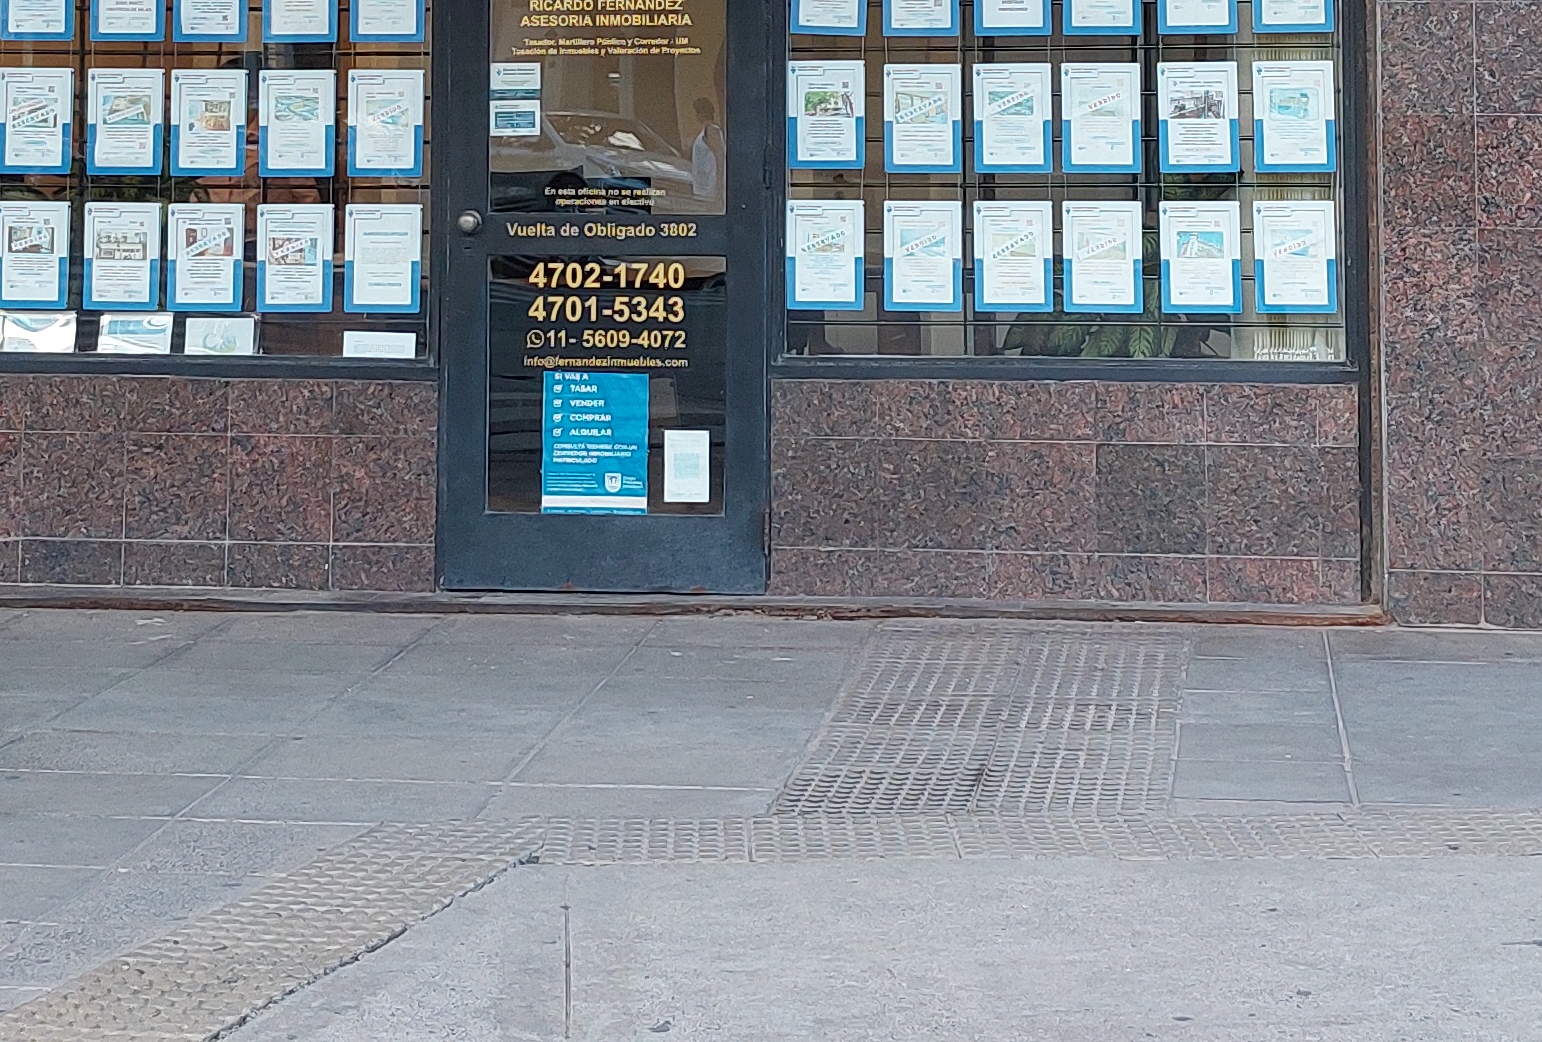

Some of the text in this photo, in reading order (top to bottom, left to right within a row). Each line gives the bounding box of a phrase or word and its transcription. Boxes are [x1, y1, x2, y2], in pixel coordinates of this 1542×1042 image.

[529, 0, 594, 11] RICARDO
[520, 13, 693, 27] ASESORIA INMOBILIARIA
[544, 187, 556, 195] En
[506, 222, 697, 240] Vuelta de Obligado 3802
[528, 262, 685, 289] 4702-1740
[528, 295, 685, 323] 4701-5343
[546, 329, 687, 349] 11- 5609-4072
[569, 399, 605, 407] VENDER
[569, 414, 611, 422] COMPRAR
